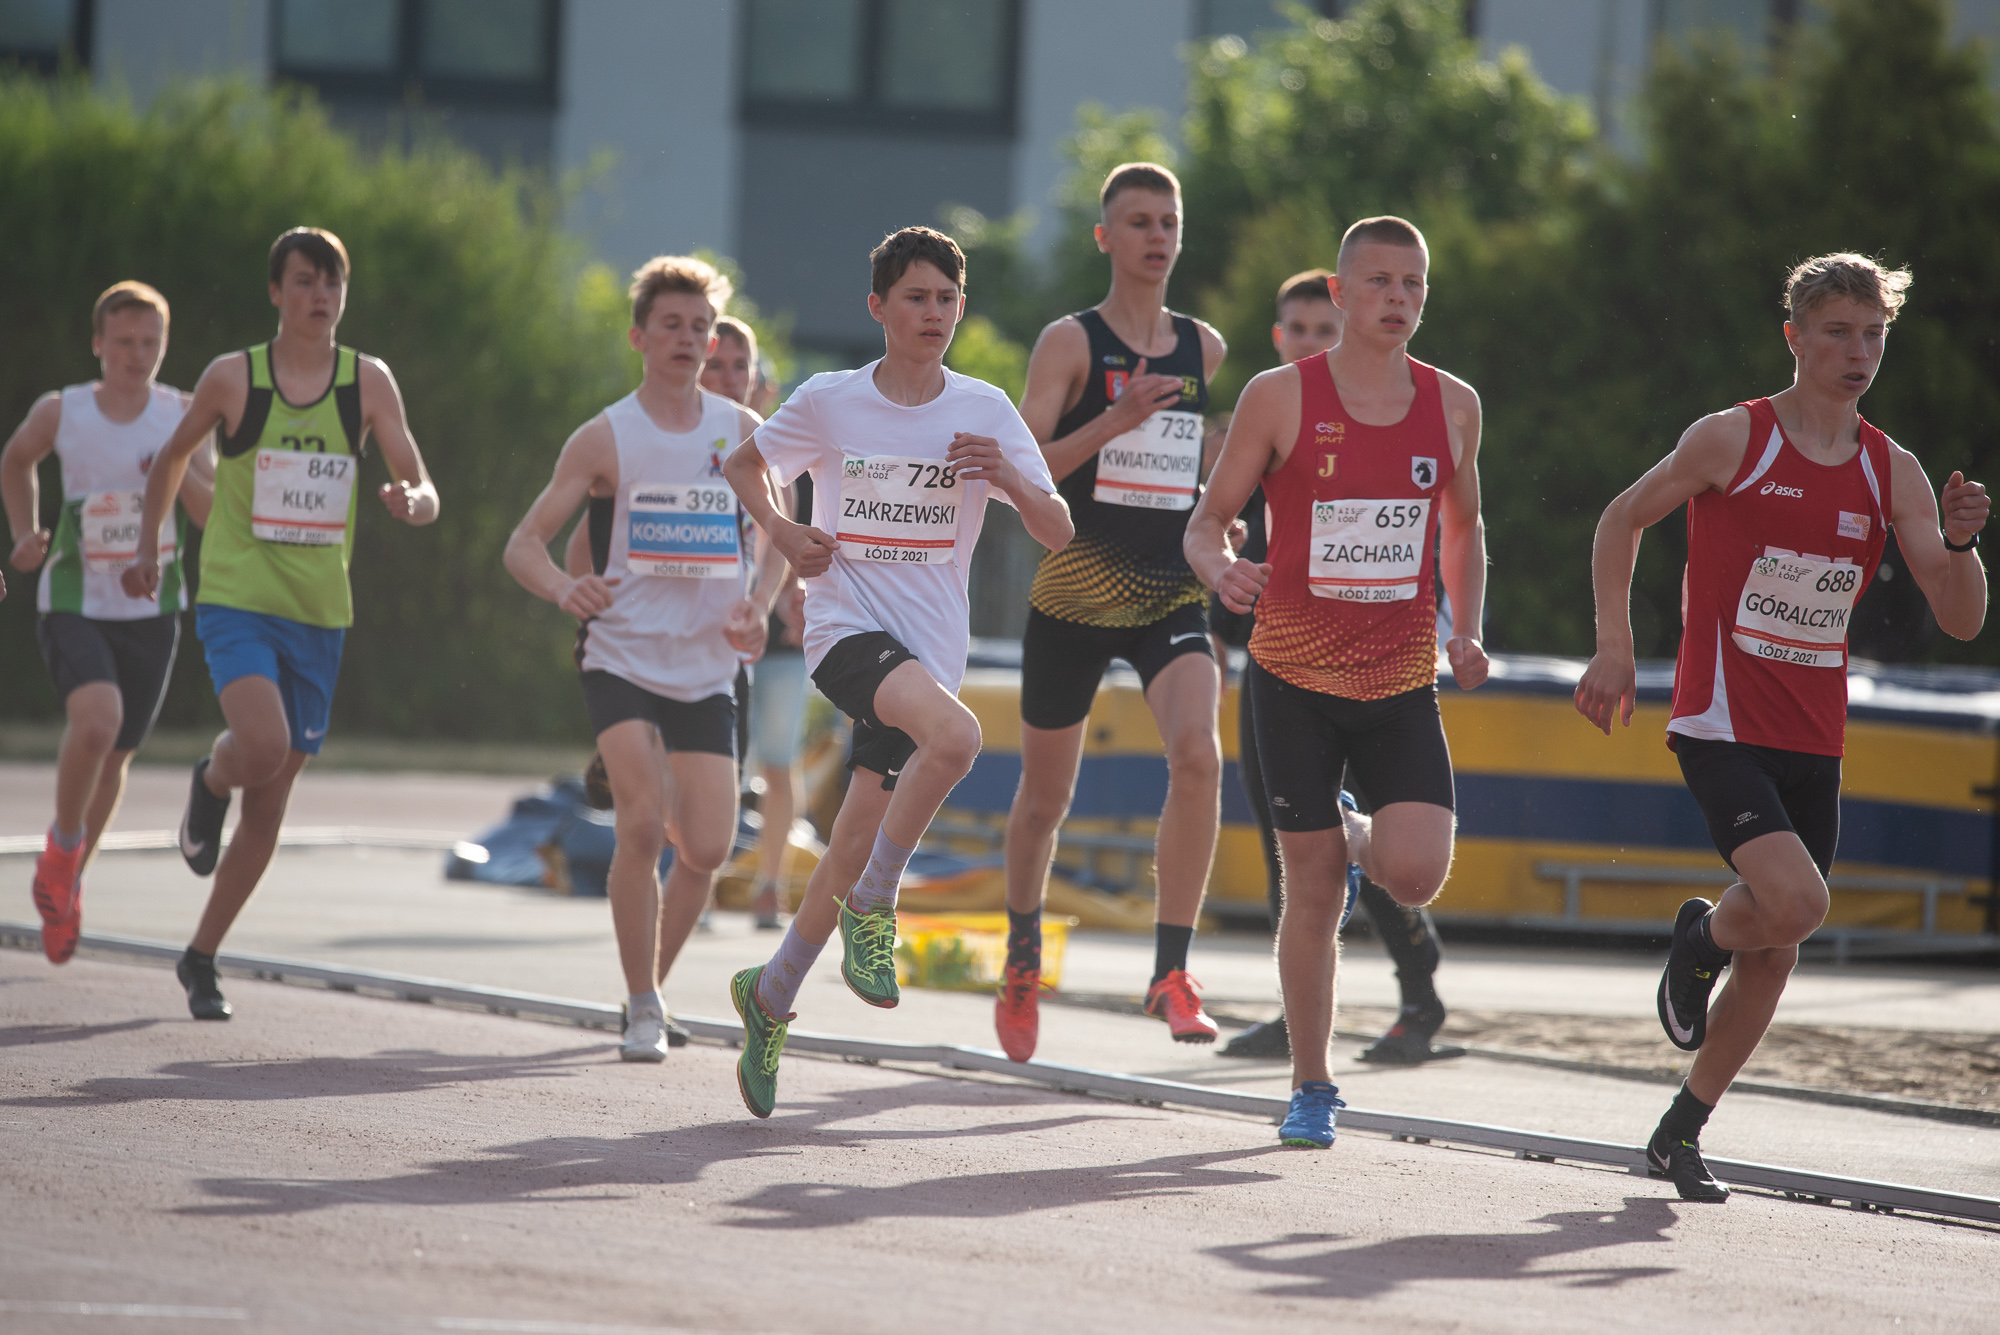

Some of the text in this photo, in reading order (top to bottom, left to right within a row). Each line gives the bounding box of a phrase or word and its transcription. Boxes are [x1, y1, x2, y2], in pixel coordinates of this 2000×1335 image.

[1161, 417, 1196, 440] 732
[307, 458, 348, 480] 847
[1102, 448, 1197, 474] KWIATKOWSKI
[1318, 454, 1337, 478] J
[907, 463, 957, 489] 728
[282, 488, 327, 513] KLĘK
[686, 489, 729, 512] 398
[1774, 484, 1804, 498] asics
[843, 498, 956, 525] ZAKRZEWSKI
[1375, 505, 1422, 528] 659
[102, 526, 140, 543] DUD
[631, 521, 736, 544] KOSMOWSKI
[864, 546, 929, 562] ŁÓDŹ 2021
[1322, 543, 1415, 564] ZACHARA
[1778, 571, 1800, 583] ŁÓDŹ
[1815, 569, 1856, 593] 688
[1338, 586, 1396, 601] ŁÓDŹ 2021
[1745, 594, 1848, 628] GÓRALCZYK
[1757, 643, 1818, 665] ŁÓDŹ 2021
